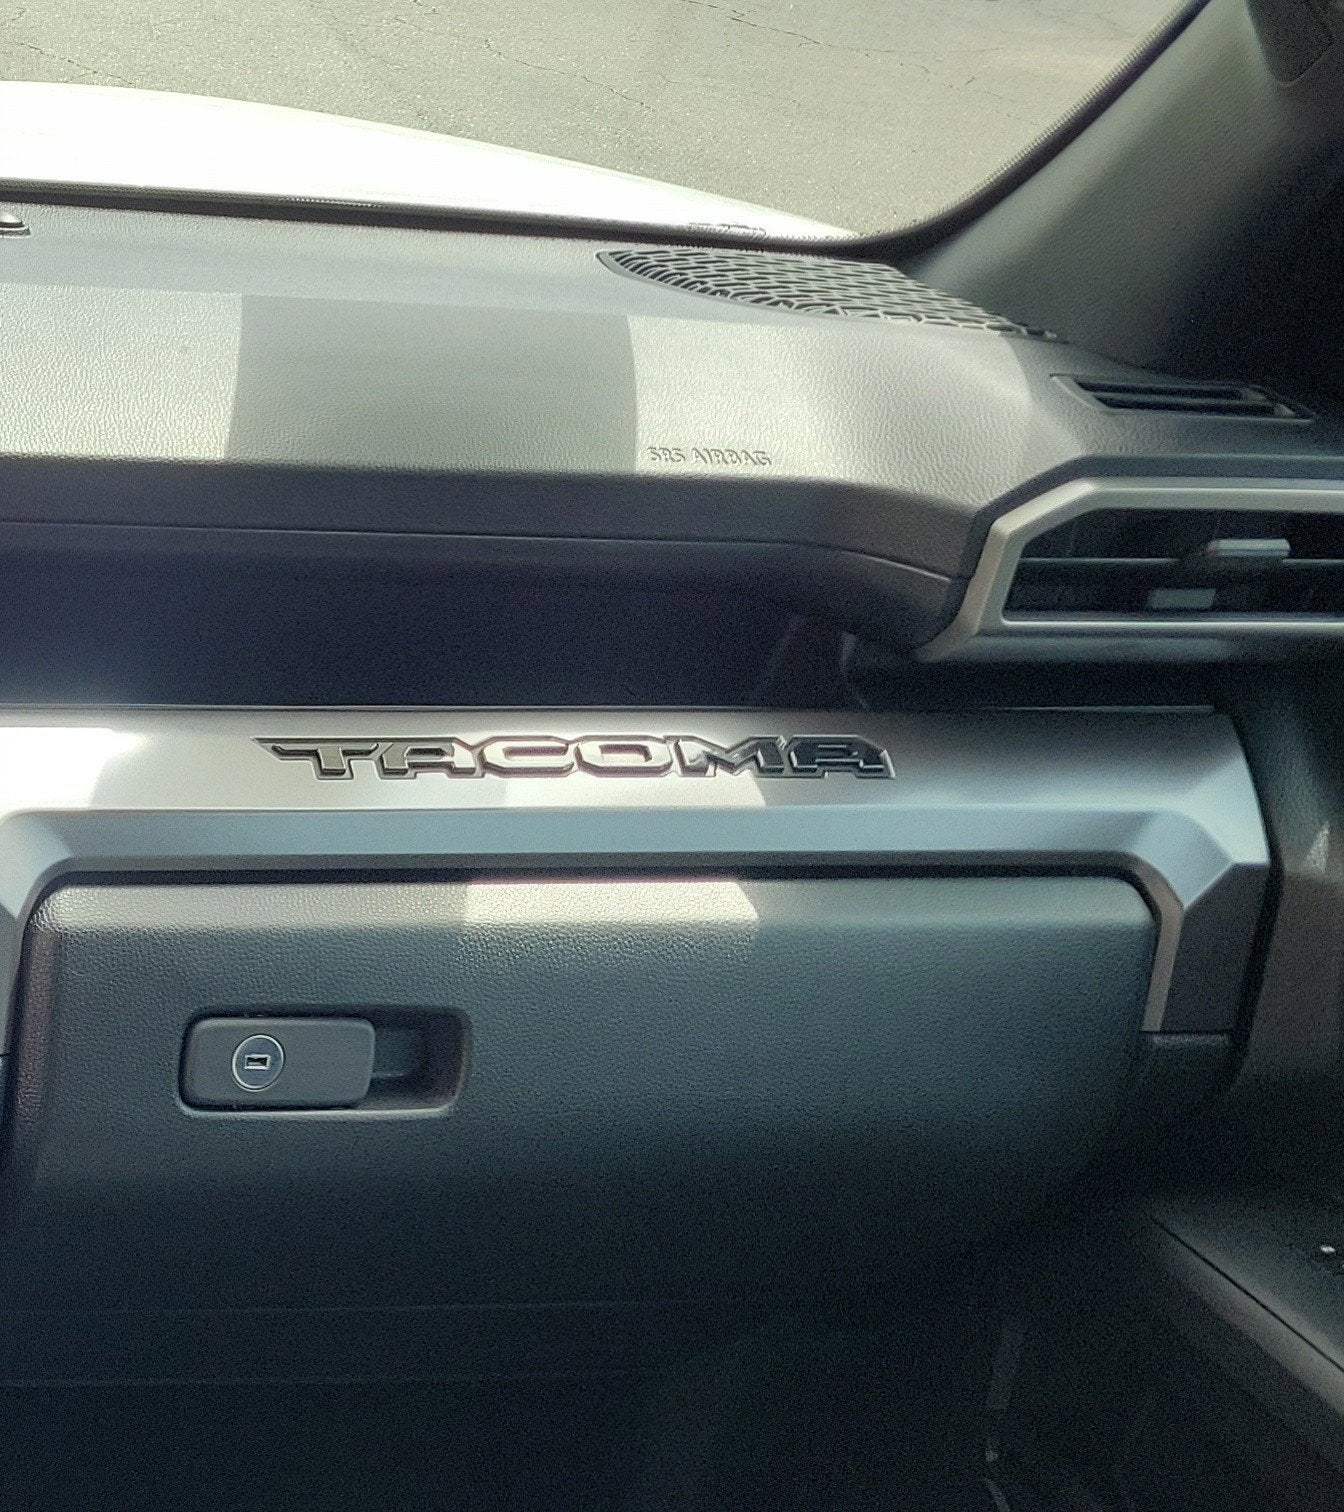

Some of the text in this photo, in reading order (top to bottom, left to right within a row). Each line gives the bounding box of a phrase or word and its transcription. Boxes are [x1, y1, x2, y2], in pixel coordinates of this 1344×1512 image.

[646, 447, 772, 466] SRS AIRBAG
[250, 735, 896, 780] TACOMA
